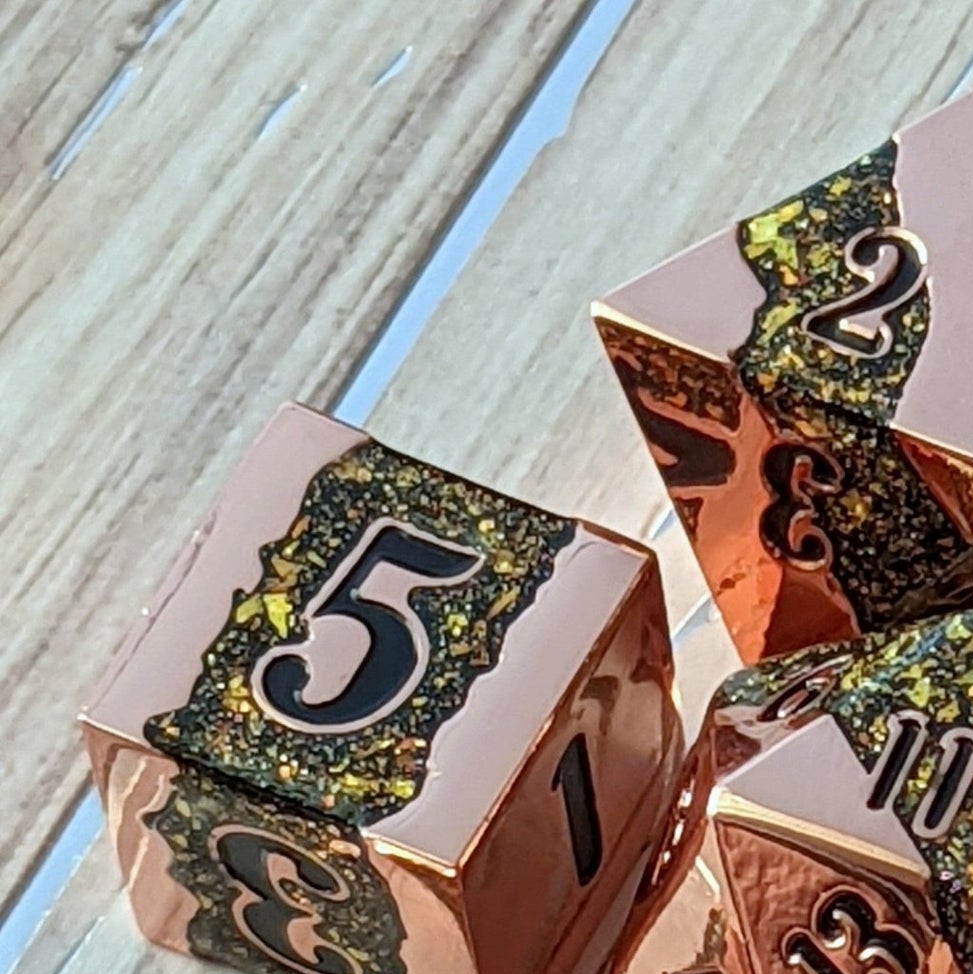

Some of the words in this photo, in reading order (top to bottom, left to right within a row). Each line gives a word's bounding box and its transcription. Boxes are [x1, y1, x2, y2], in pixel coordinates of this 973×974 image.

[804, 227, 929, 358] 2
[761, 440, 846, 567] 3
[253, 518, 484, 733] 5
[551, 733, 602, 887] 1
